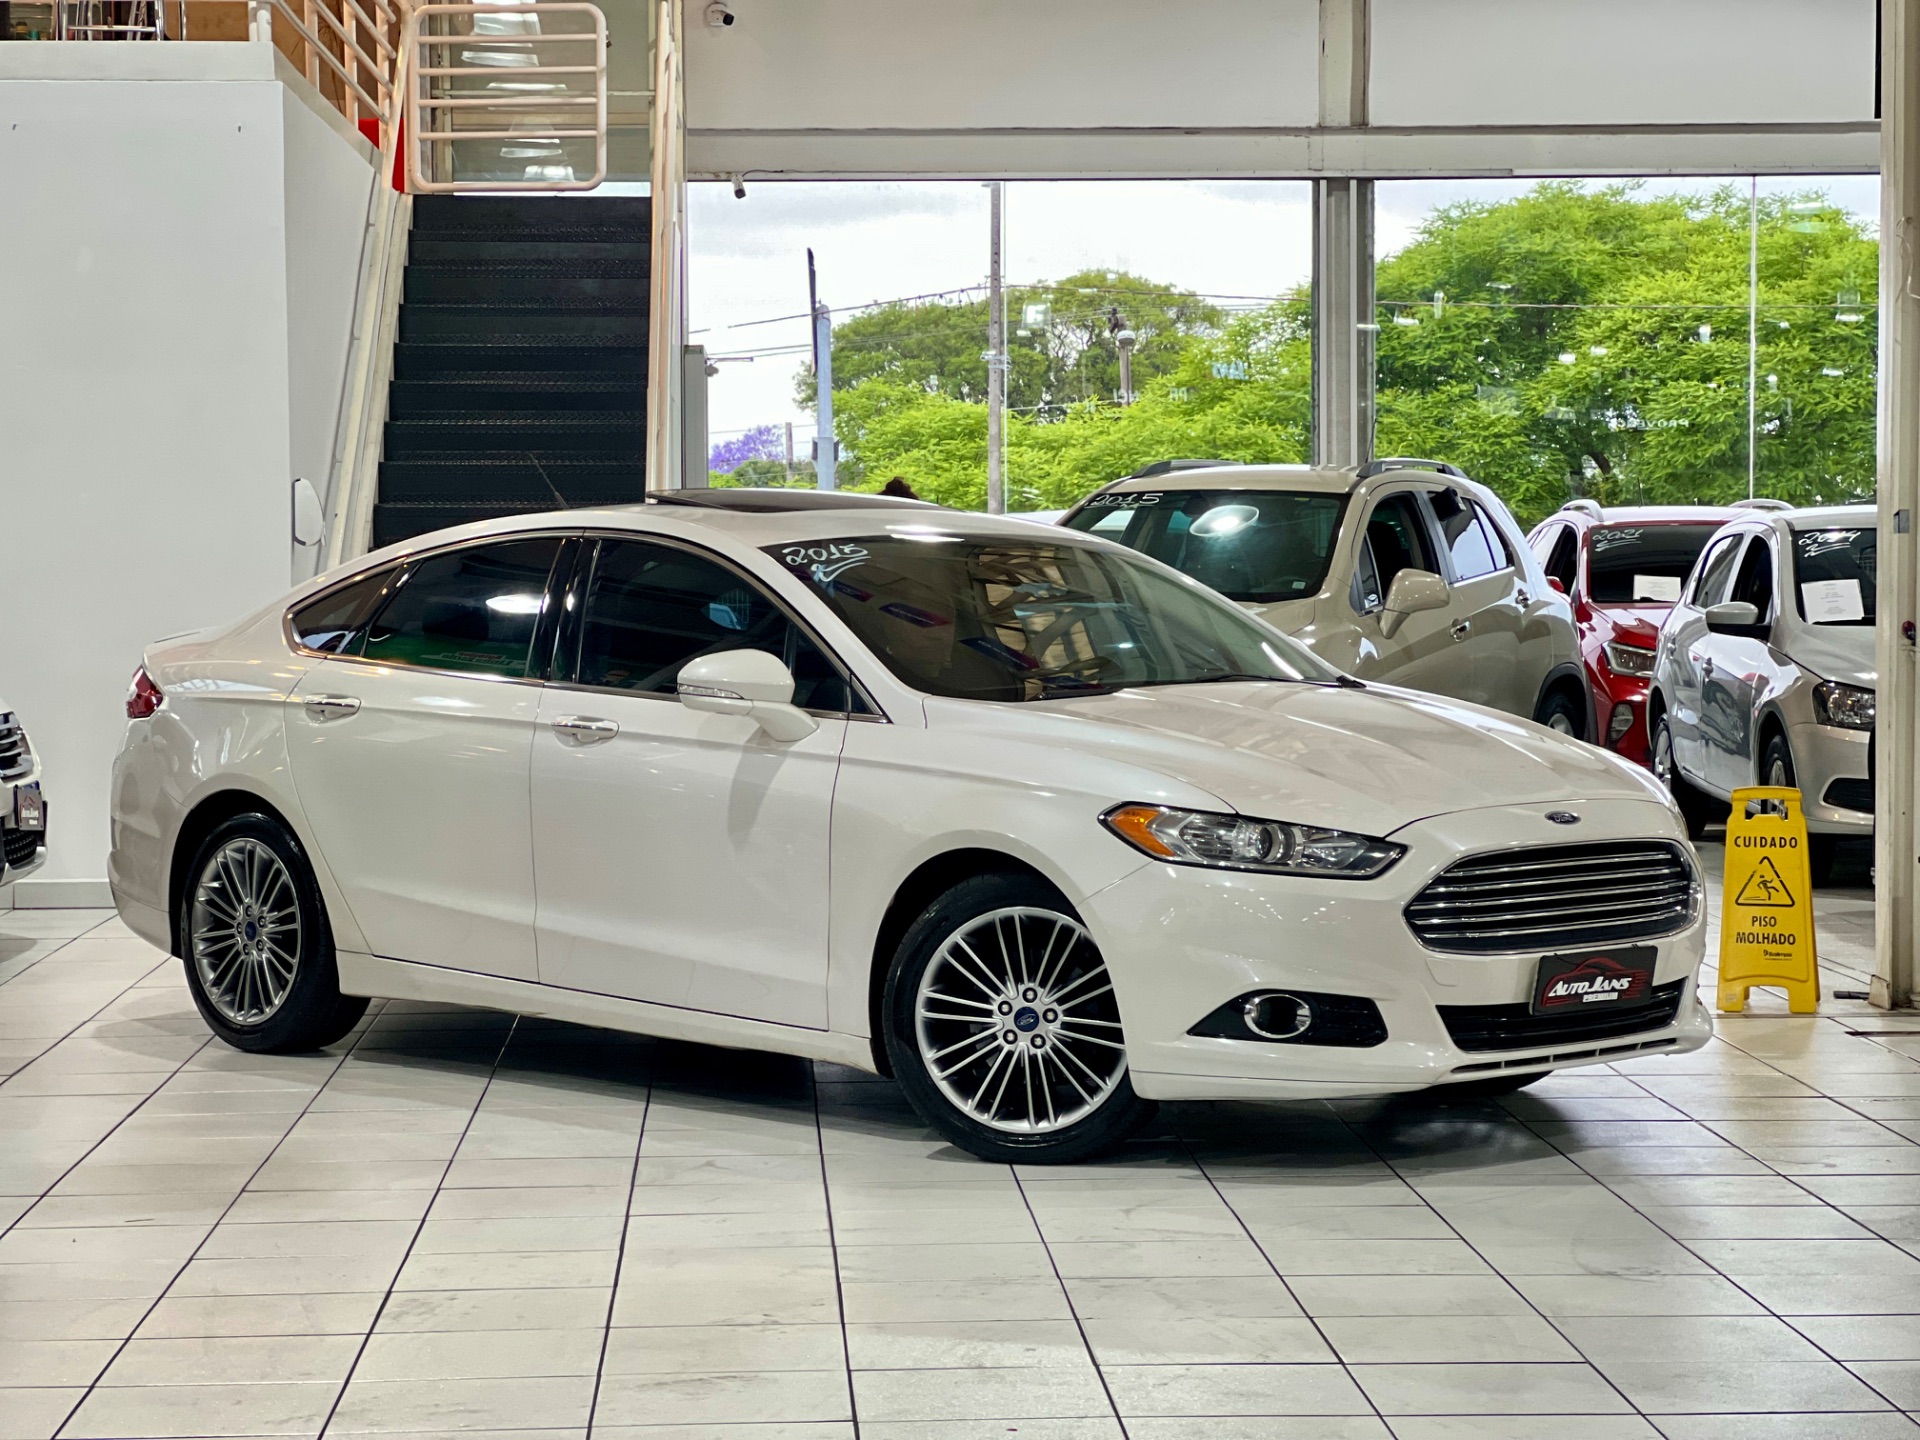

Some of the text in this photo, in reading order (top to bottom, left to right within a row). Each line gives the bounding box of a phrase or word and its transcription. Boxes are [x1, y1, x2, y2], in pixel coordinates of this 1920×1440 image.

[1090, 493, 1164, 506] 2015
[1798, 530, 1862, 545] 204
[782, 543, 869, 565] 2015
[1734, 835, 1798, 848] CUIDADO
[1751, 915, 1777, 927] PISO
[1735, 931, 1796, 945] MOLHADO
